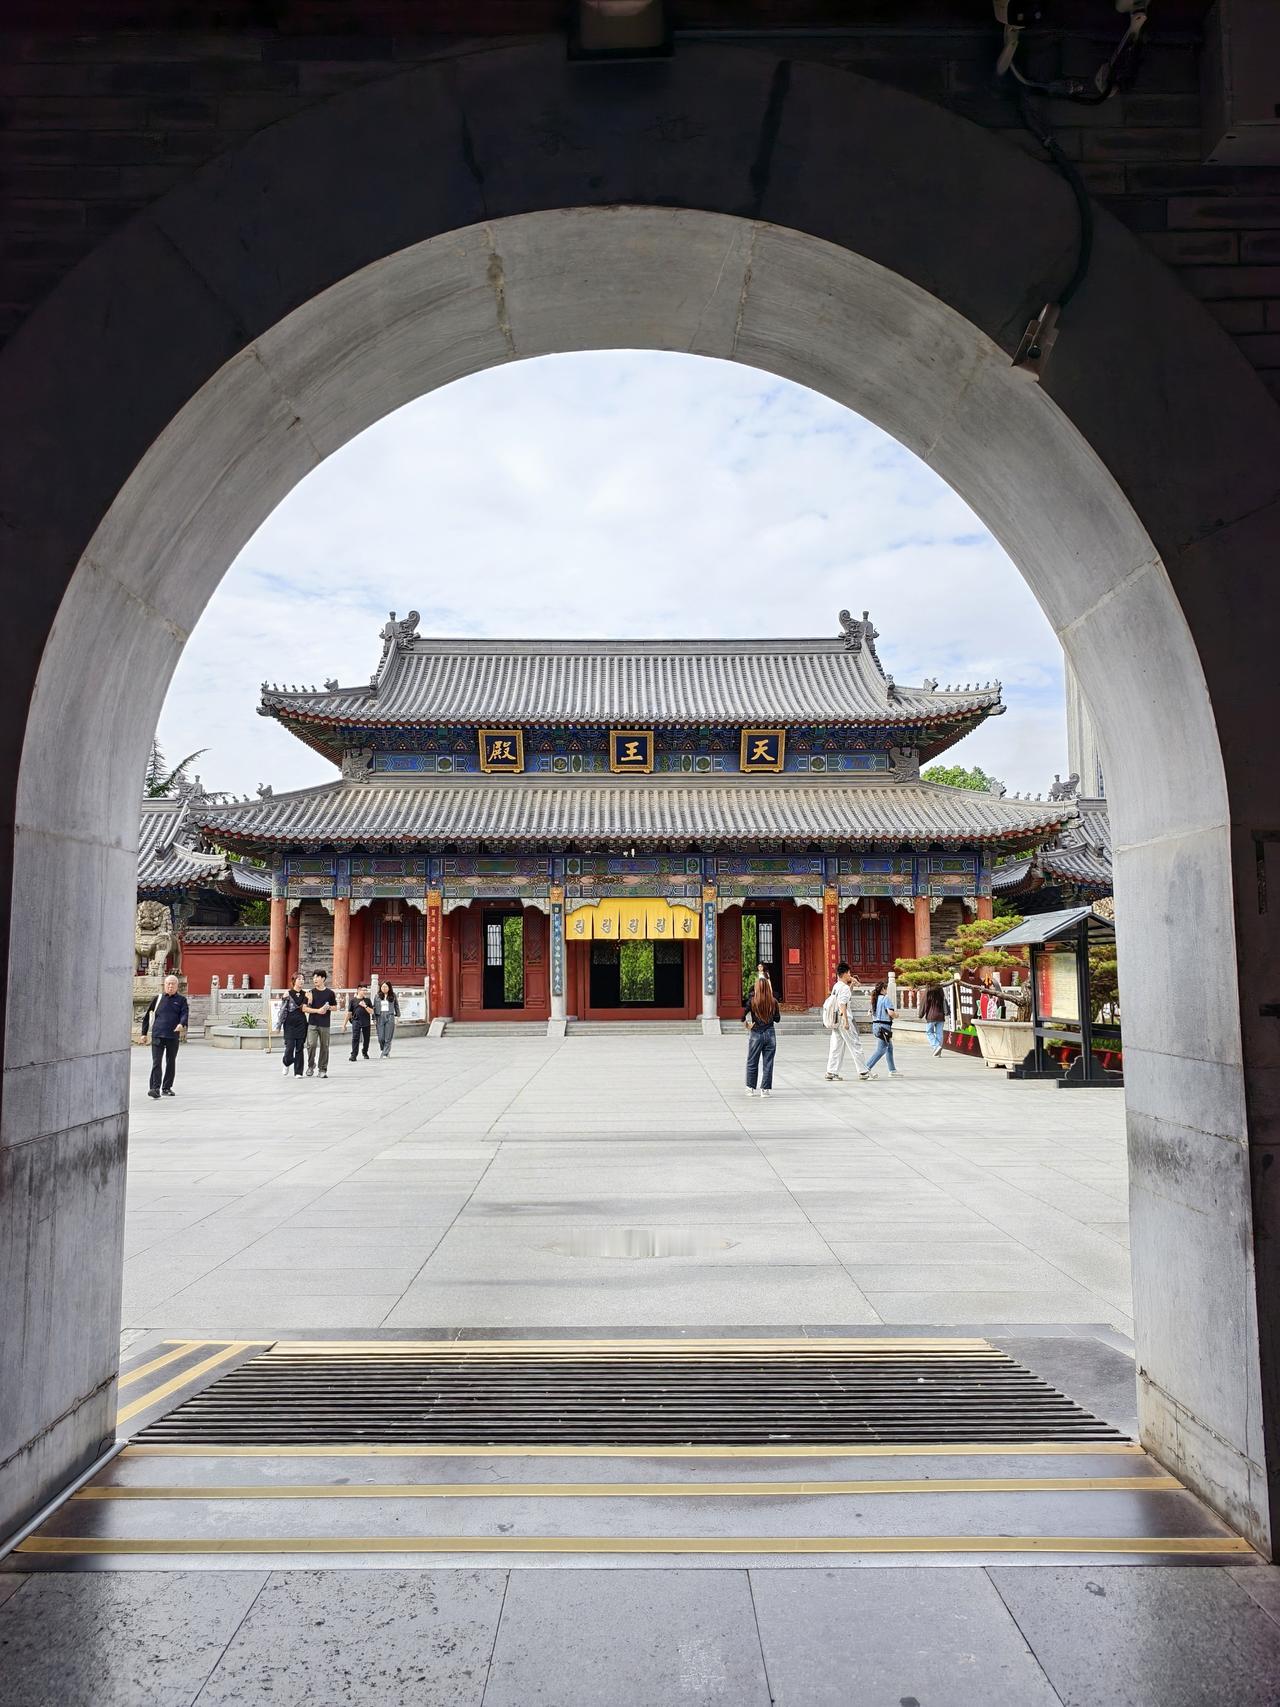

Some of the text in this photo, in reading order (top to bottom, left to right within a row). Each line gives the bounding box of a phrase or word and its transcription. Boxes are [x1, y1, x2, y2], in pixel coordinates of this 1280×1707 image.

[488, 740, 516, 762] 殿
[620, 741, 644, 761] 王
[752, 739, 776, 762] 天
